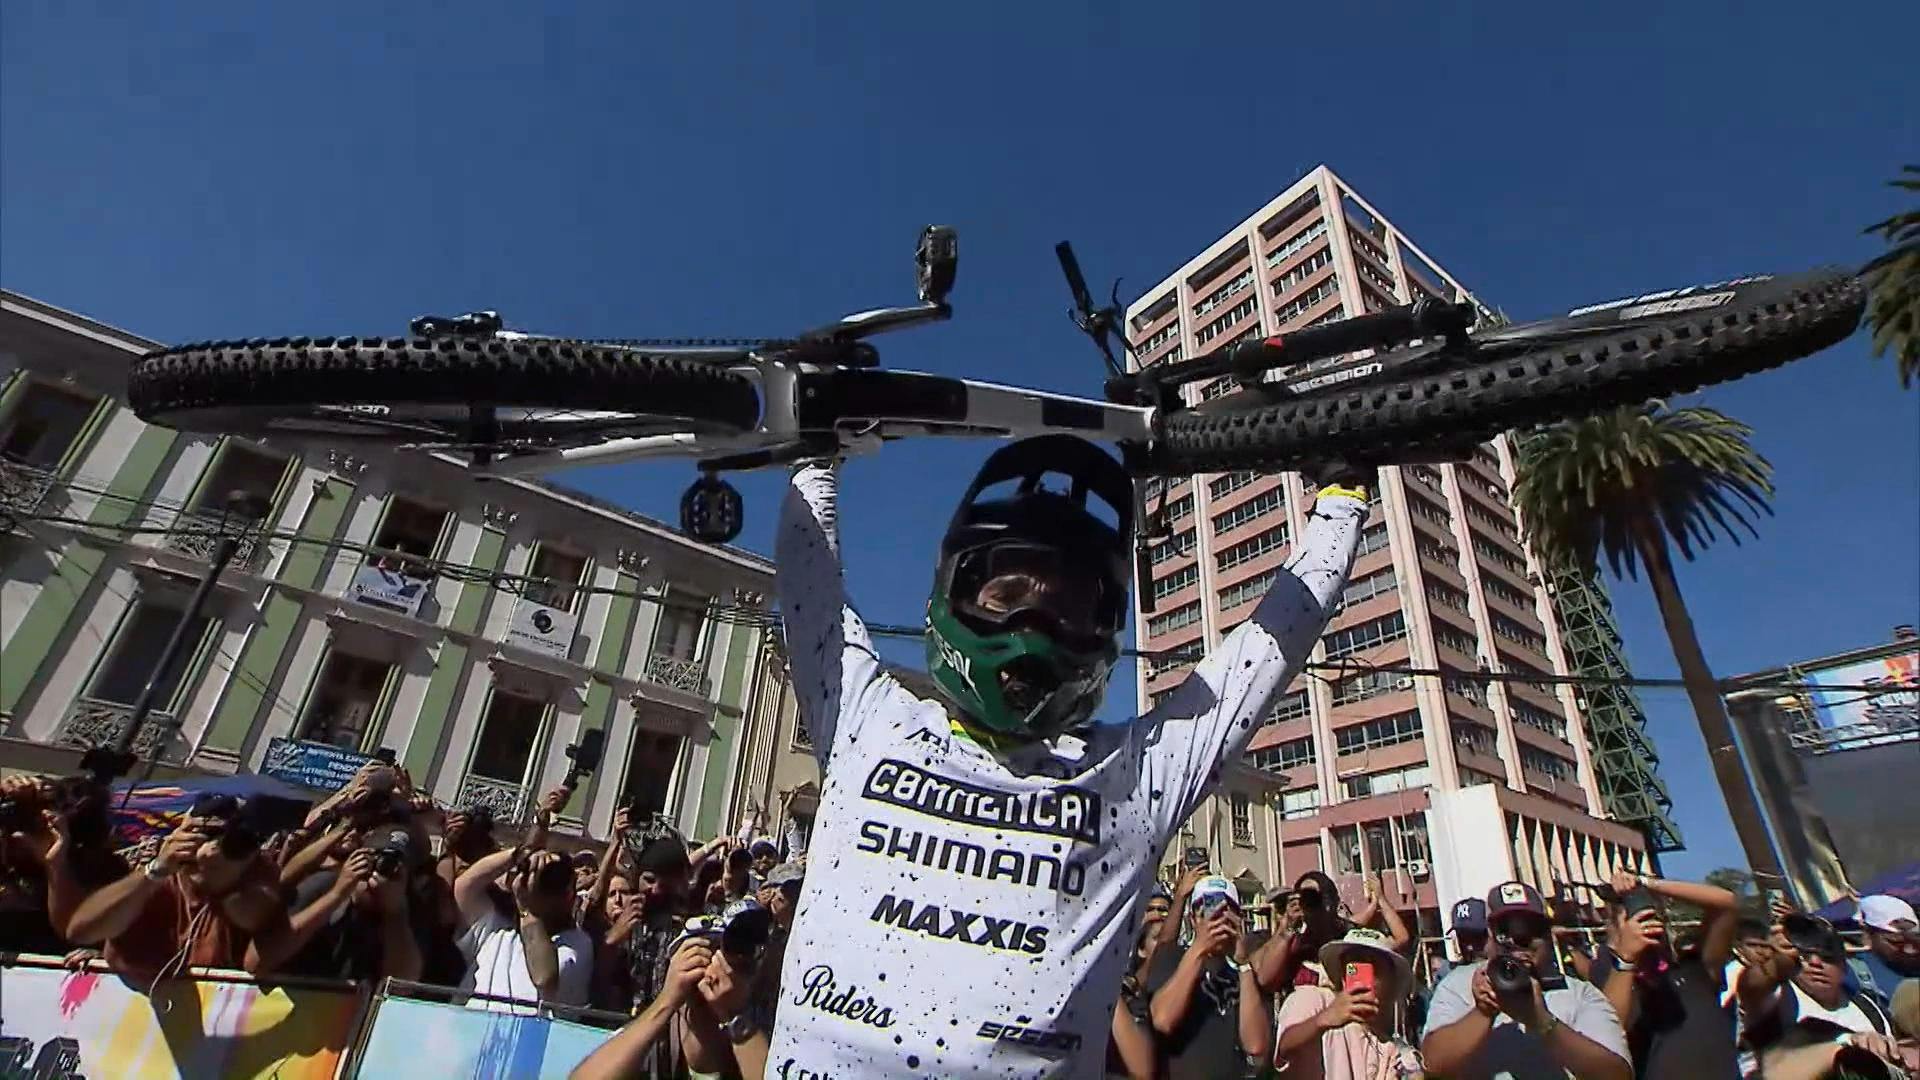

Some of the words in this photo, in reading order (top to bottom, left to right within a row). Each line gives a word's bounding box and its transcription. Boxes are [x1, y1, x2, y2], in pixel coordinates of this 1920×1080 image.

[857, 820, 1085, 896] SHIMANO
[870, 894, 1049, 954] MAXXIS
[794, 965, 896, 1028] Riders
